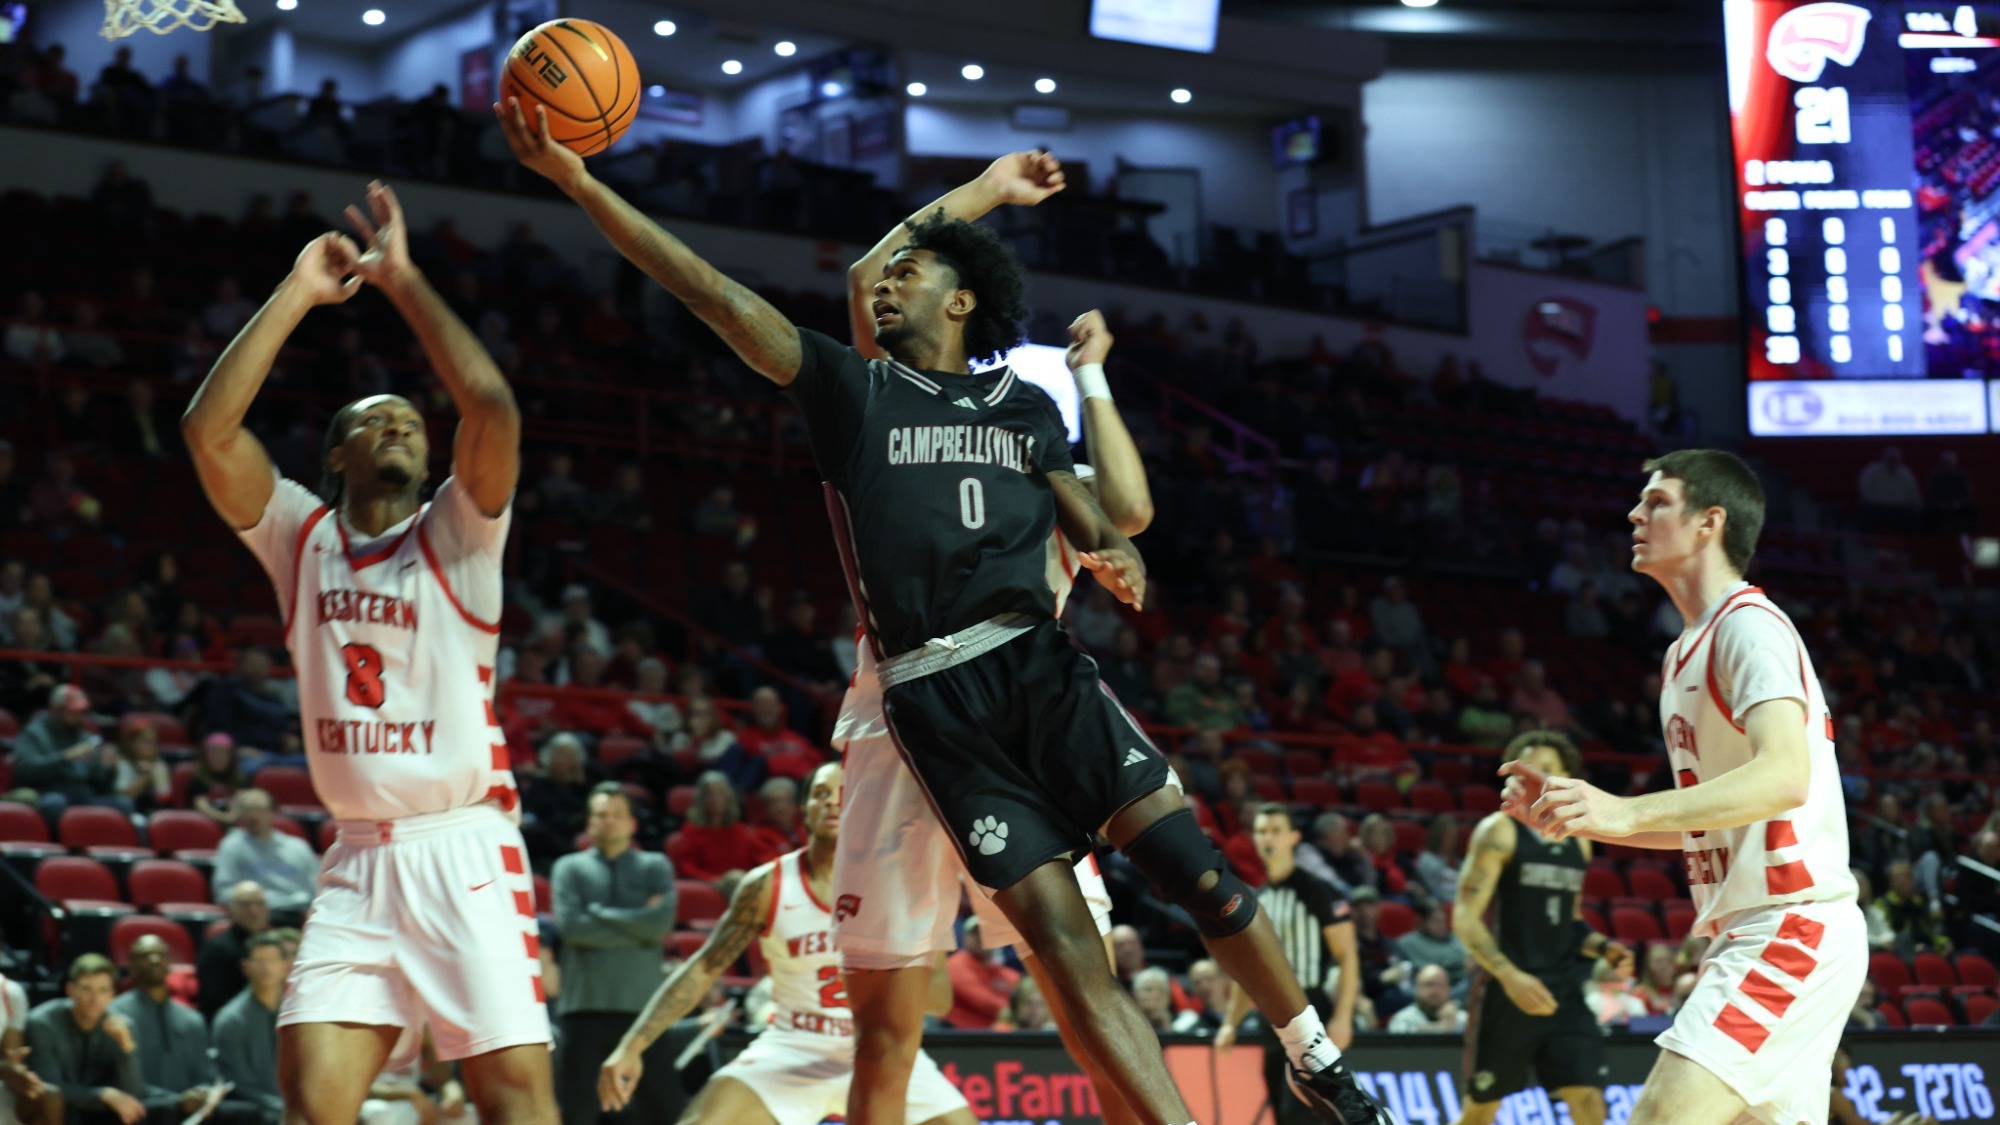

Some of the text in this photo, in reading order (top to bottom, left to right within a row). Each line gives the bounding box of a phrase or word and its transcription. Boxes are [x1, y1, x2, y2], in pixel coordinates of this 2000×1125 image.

[519, 37, 568, 89] ELITE
[1794, 87, 1850, 143] 21
[960, 478, 985, 529] 0
[342, 643, 386, 709] 8
[818, 966, 848, 1007] 2
